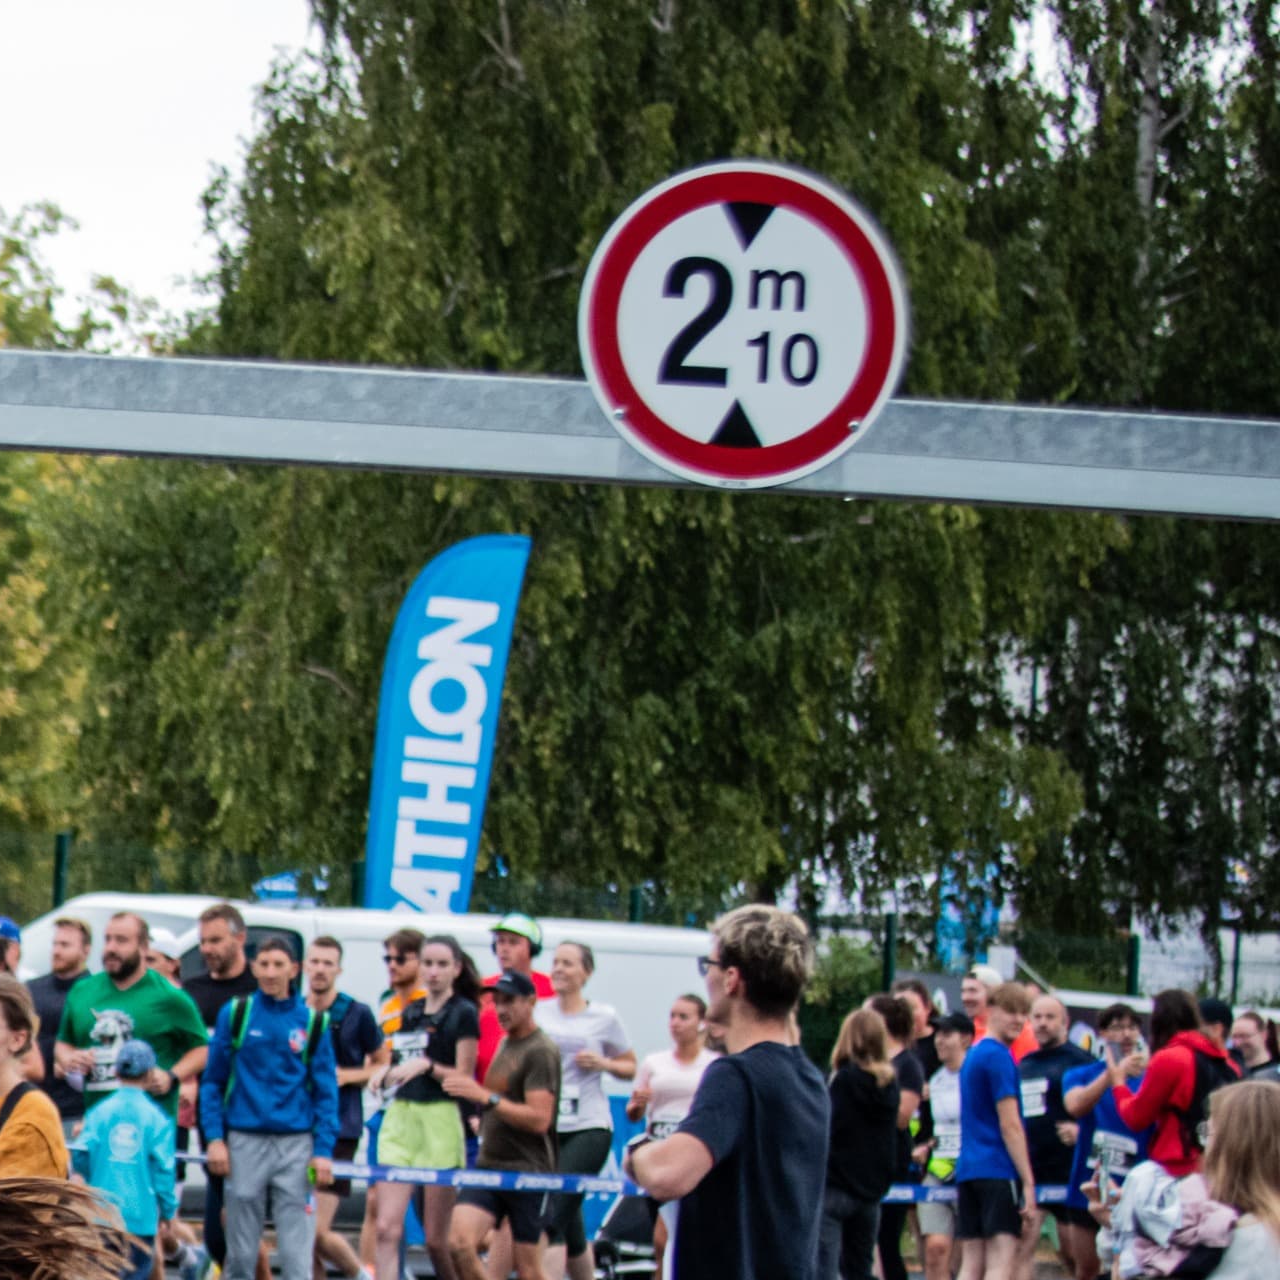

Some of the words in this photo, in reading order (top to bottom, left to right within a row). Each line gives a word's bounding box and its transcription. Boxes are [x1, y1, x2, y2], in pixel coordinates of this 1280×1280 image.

[656, 255, 734, 388] 2
[748, 269, 806, 312] m
[746, 330, 819, 387] 10
[390, 596, 500, 914] ATHLON
